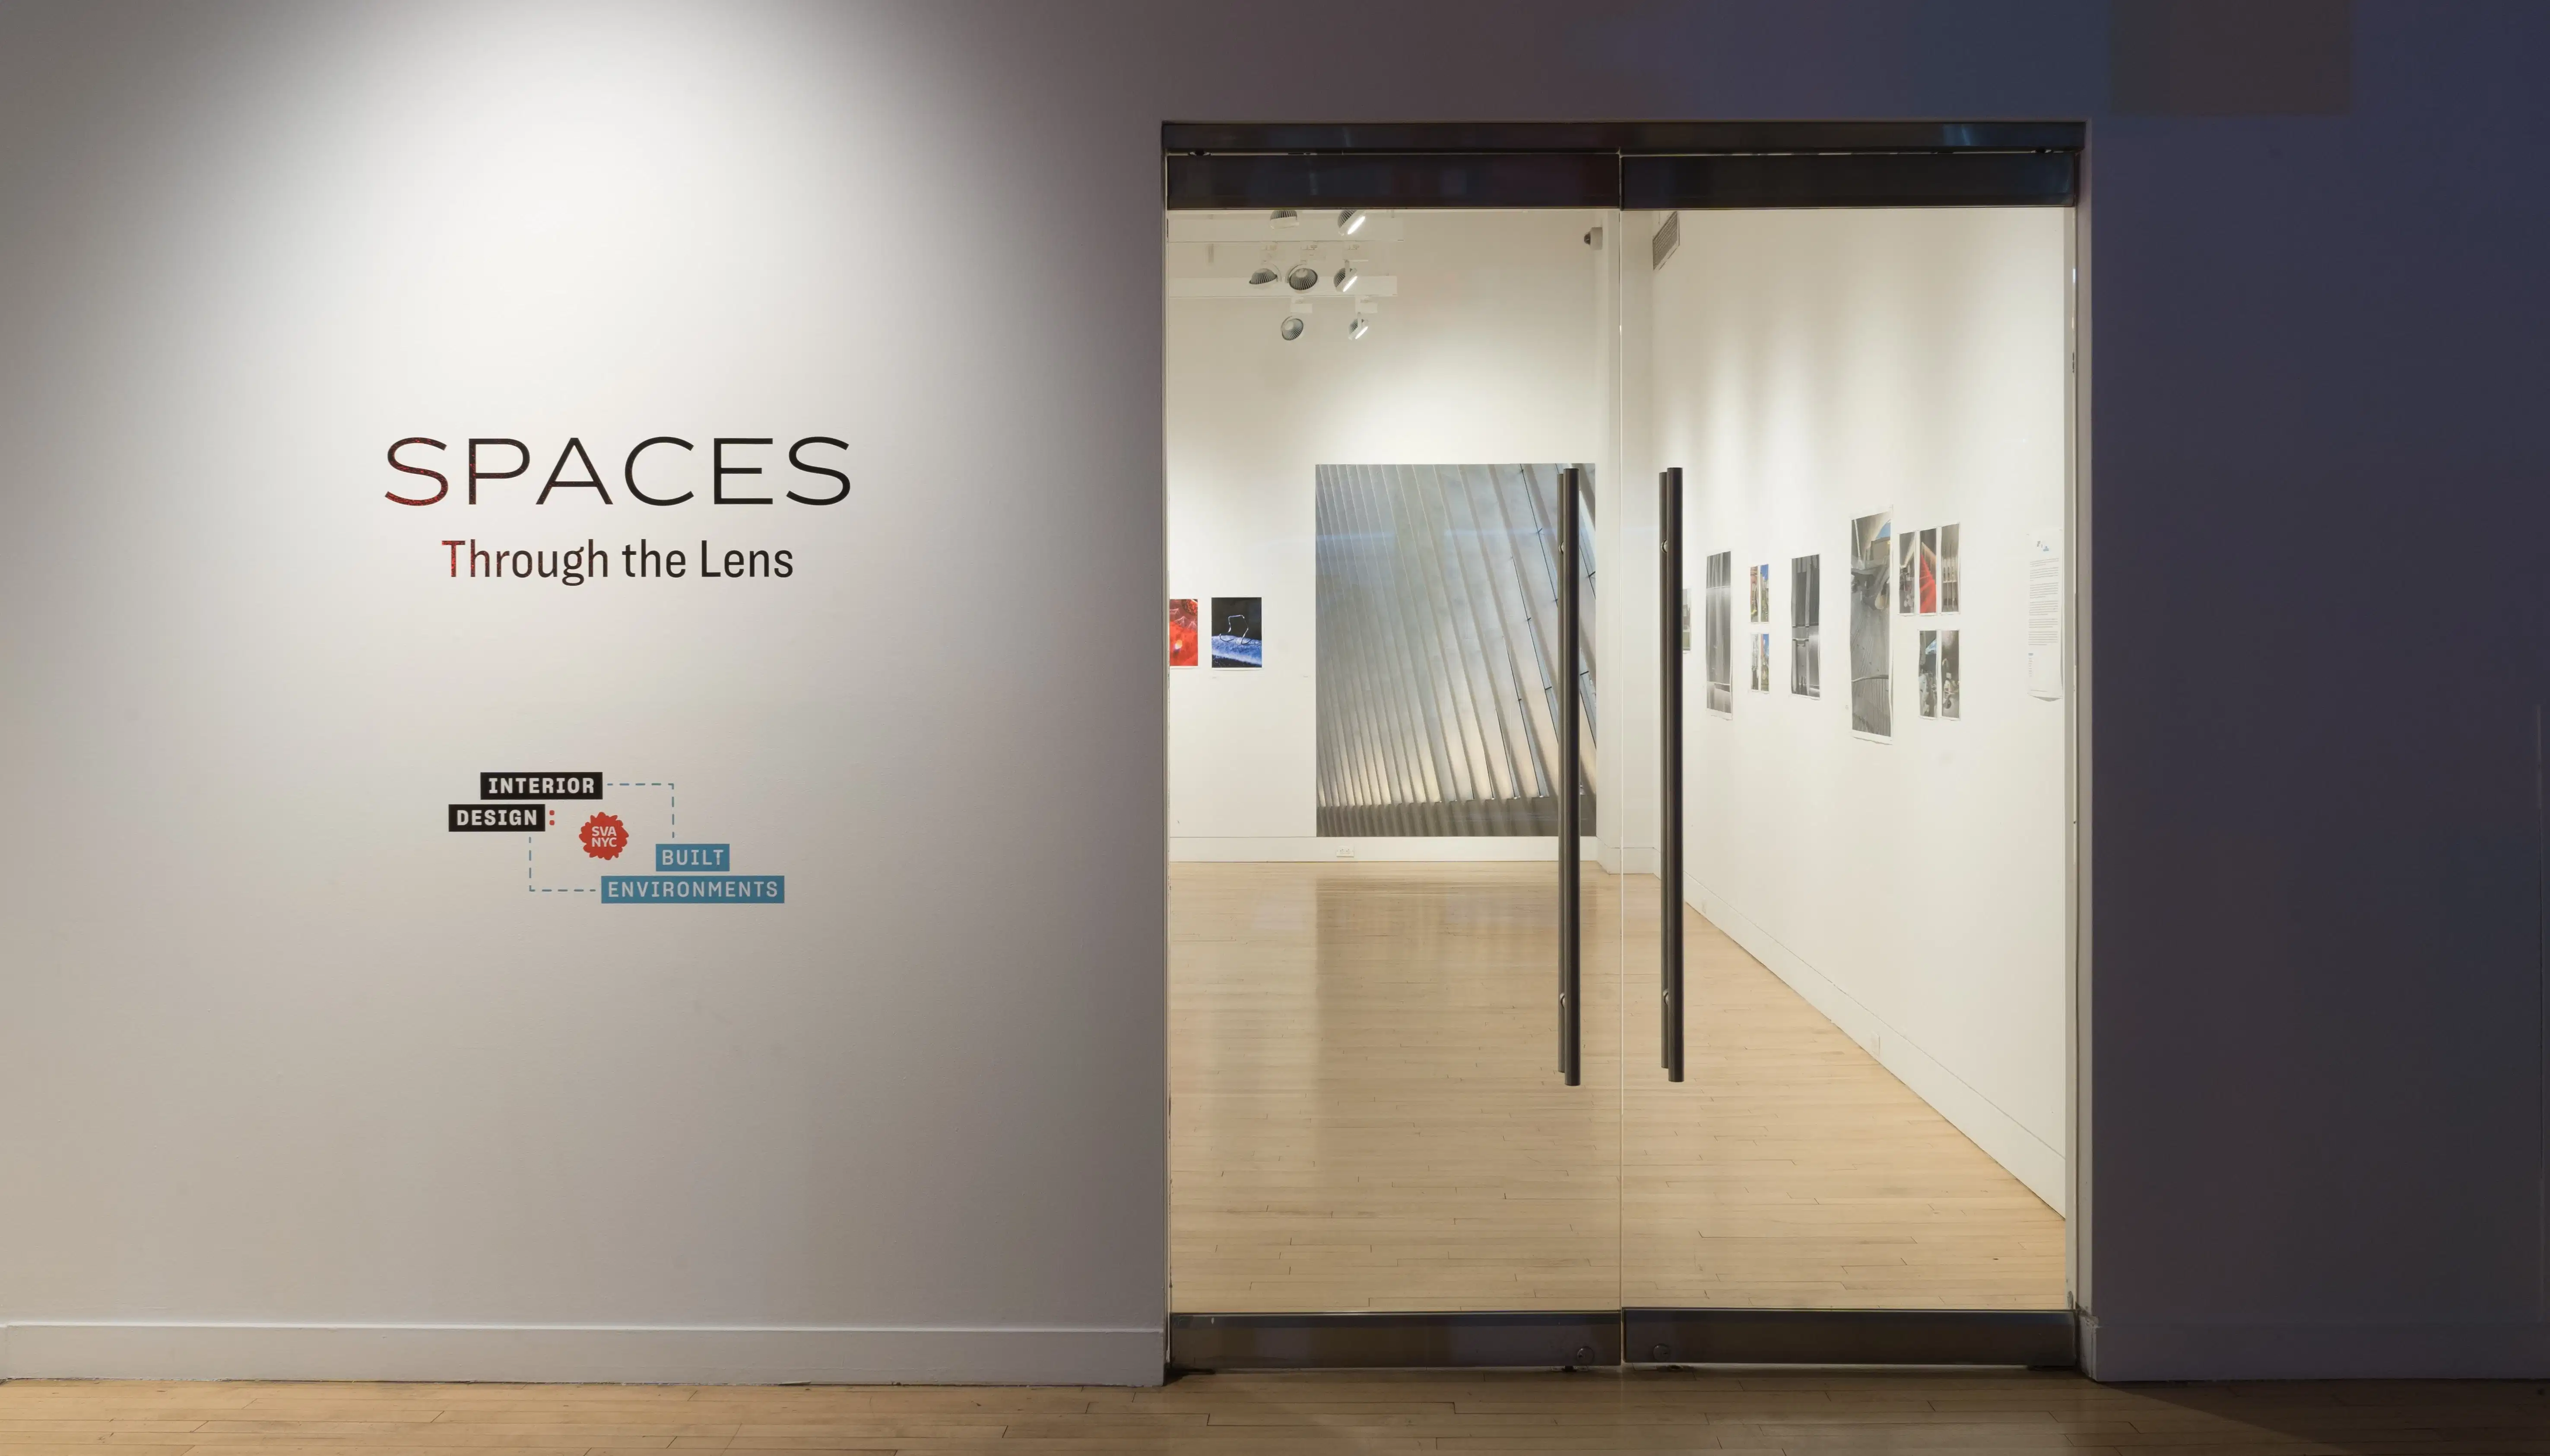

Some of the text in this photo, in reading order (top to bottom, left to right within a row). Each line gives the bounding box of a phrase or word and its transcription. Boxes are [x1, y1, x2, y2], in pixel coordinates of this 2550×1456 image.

[384, 436, 851, 506] SPACES
[441, 539, 793, 586] Through the Lens
[488, 777, 594, 793] INTERIOR
[591, 826, 617, 837] SVA
[591, 837, 617, 847] NYC
[662, 850, 724, 866] BUILT
[608, 881, 778, 897] ENVIRONMENTS
